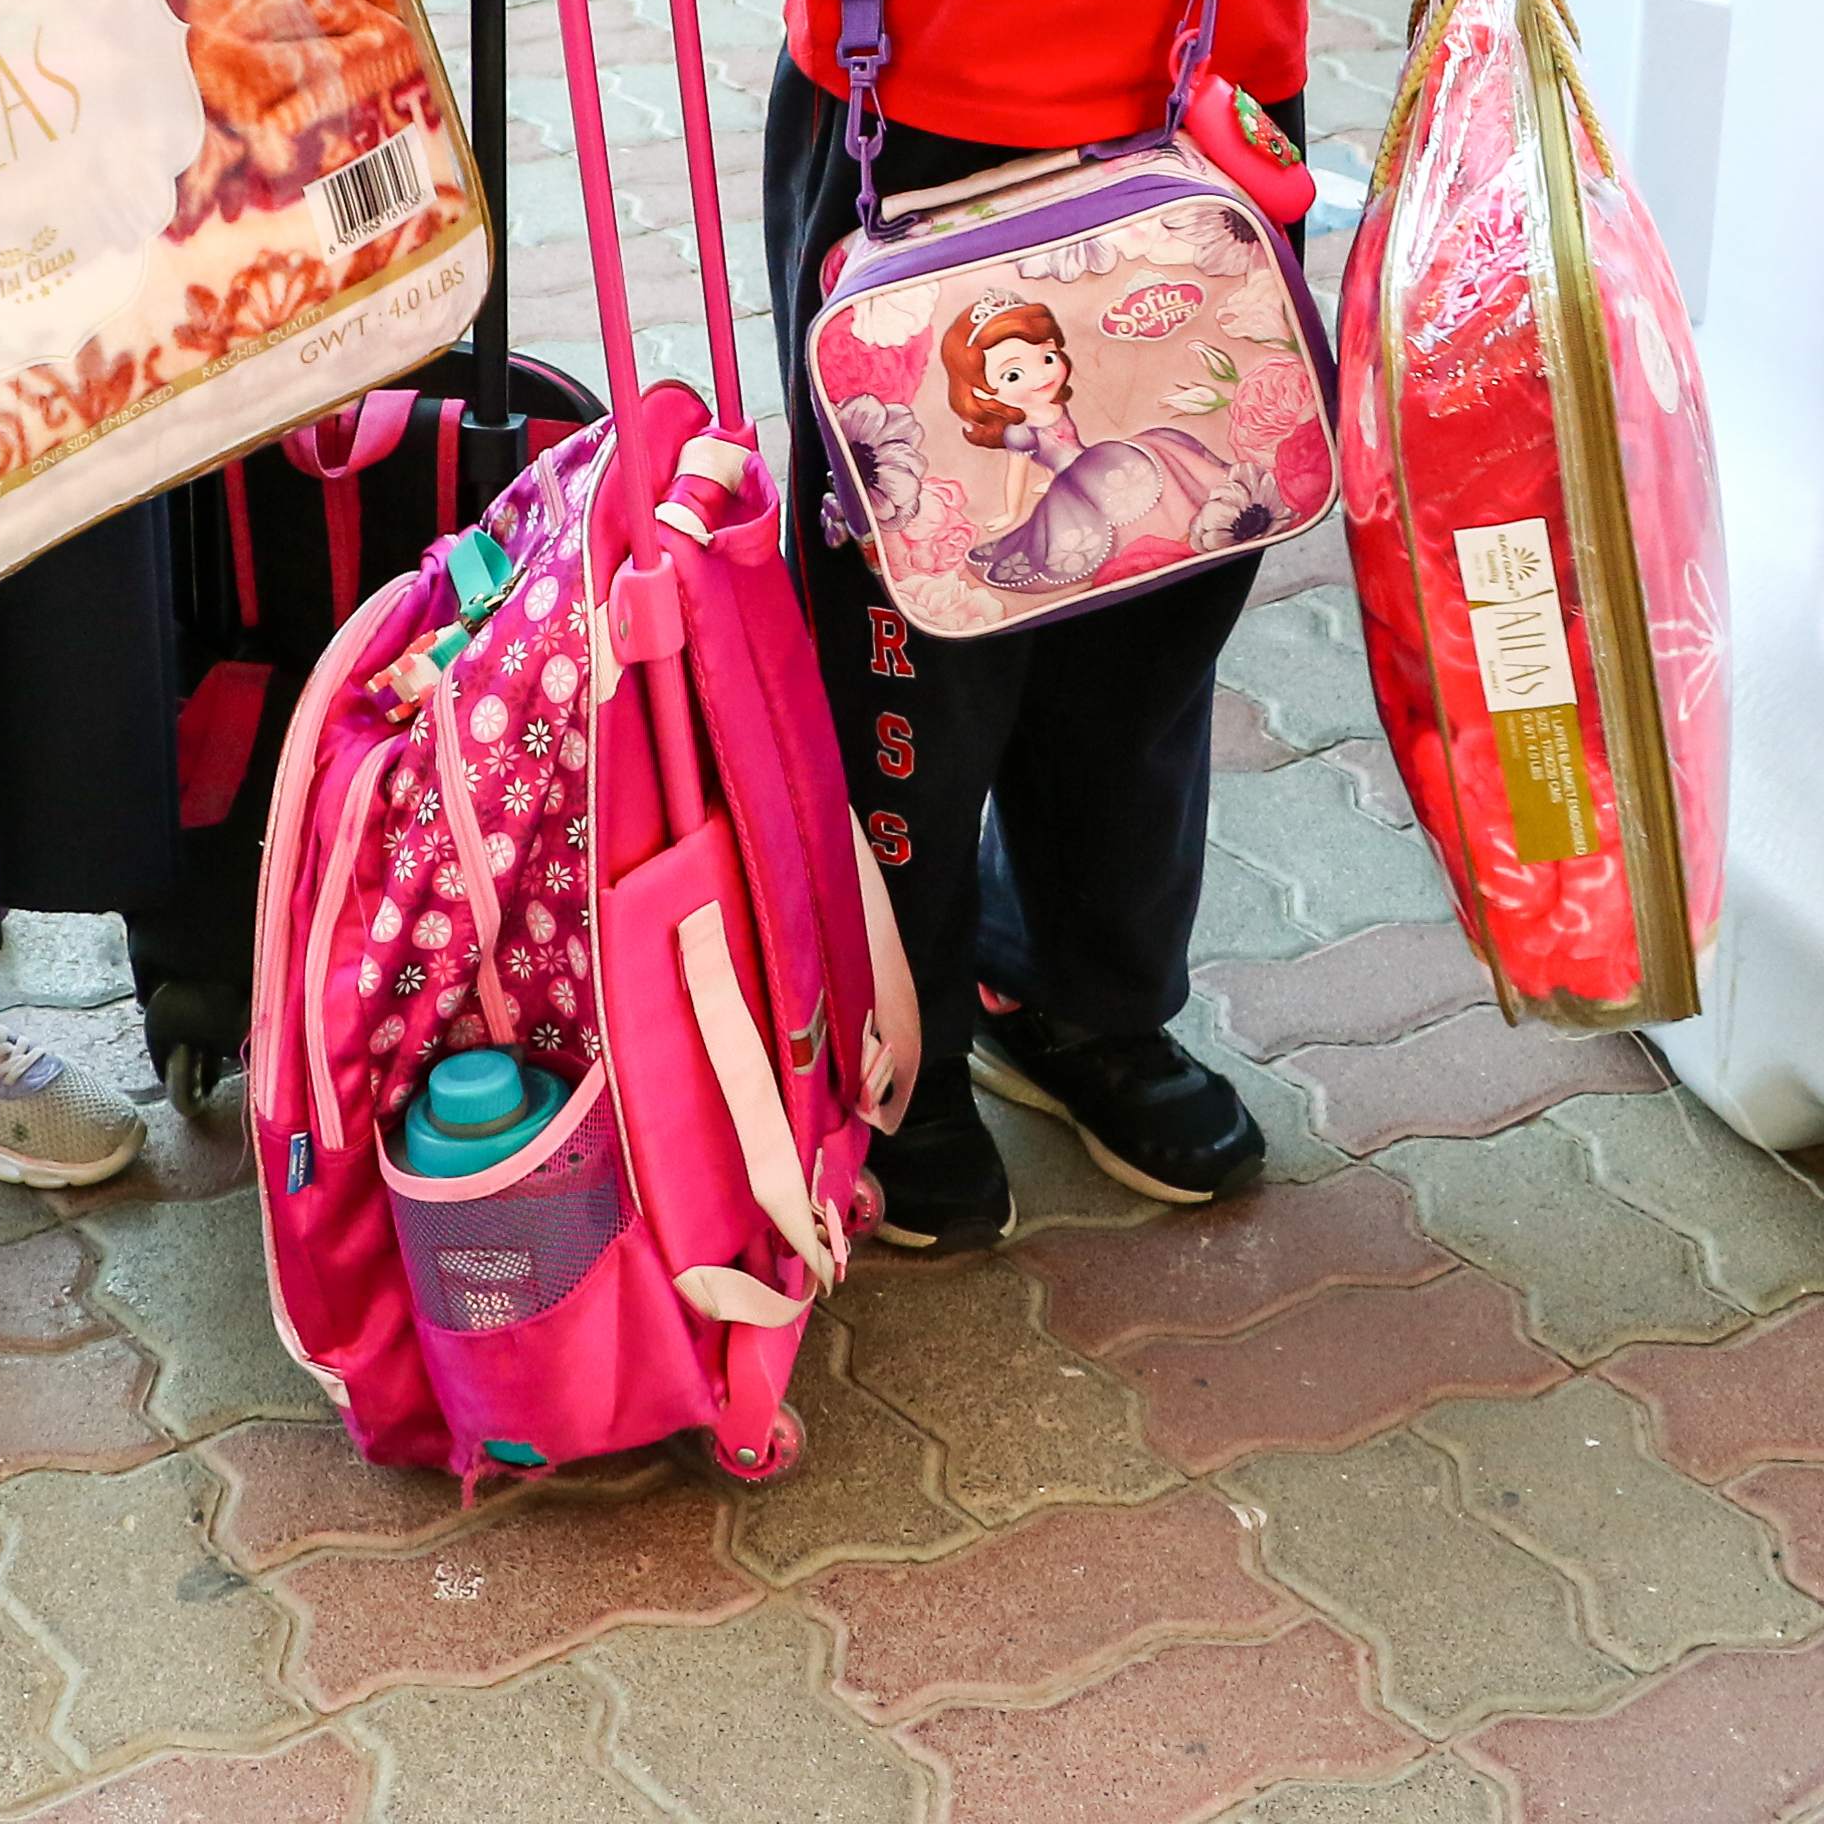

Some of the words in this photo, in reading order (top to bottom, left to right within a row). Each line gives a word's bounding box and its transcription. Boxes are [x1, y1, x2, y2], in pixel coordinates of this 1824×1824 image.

[388, 288, 420, 319] 4.0
[427, 260, 466, 302] LBS
[1107, 285, 1184, 338] Sofia
[30, 447, 64, 475] ONE
[65, 428, 98, 456] SIDE
[99, 384, 175, 435] EMBOSSED
[201, 339, 263, 379] RASCHEL
[266, 305, 326, 345] QUALITY
